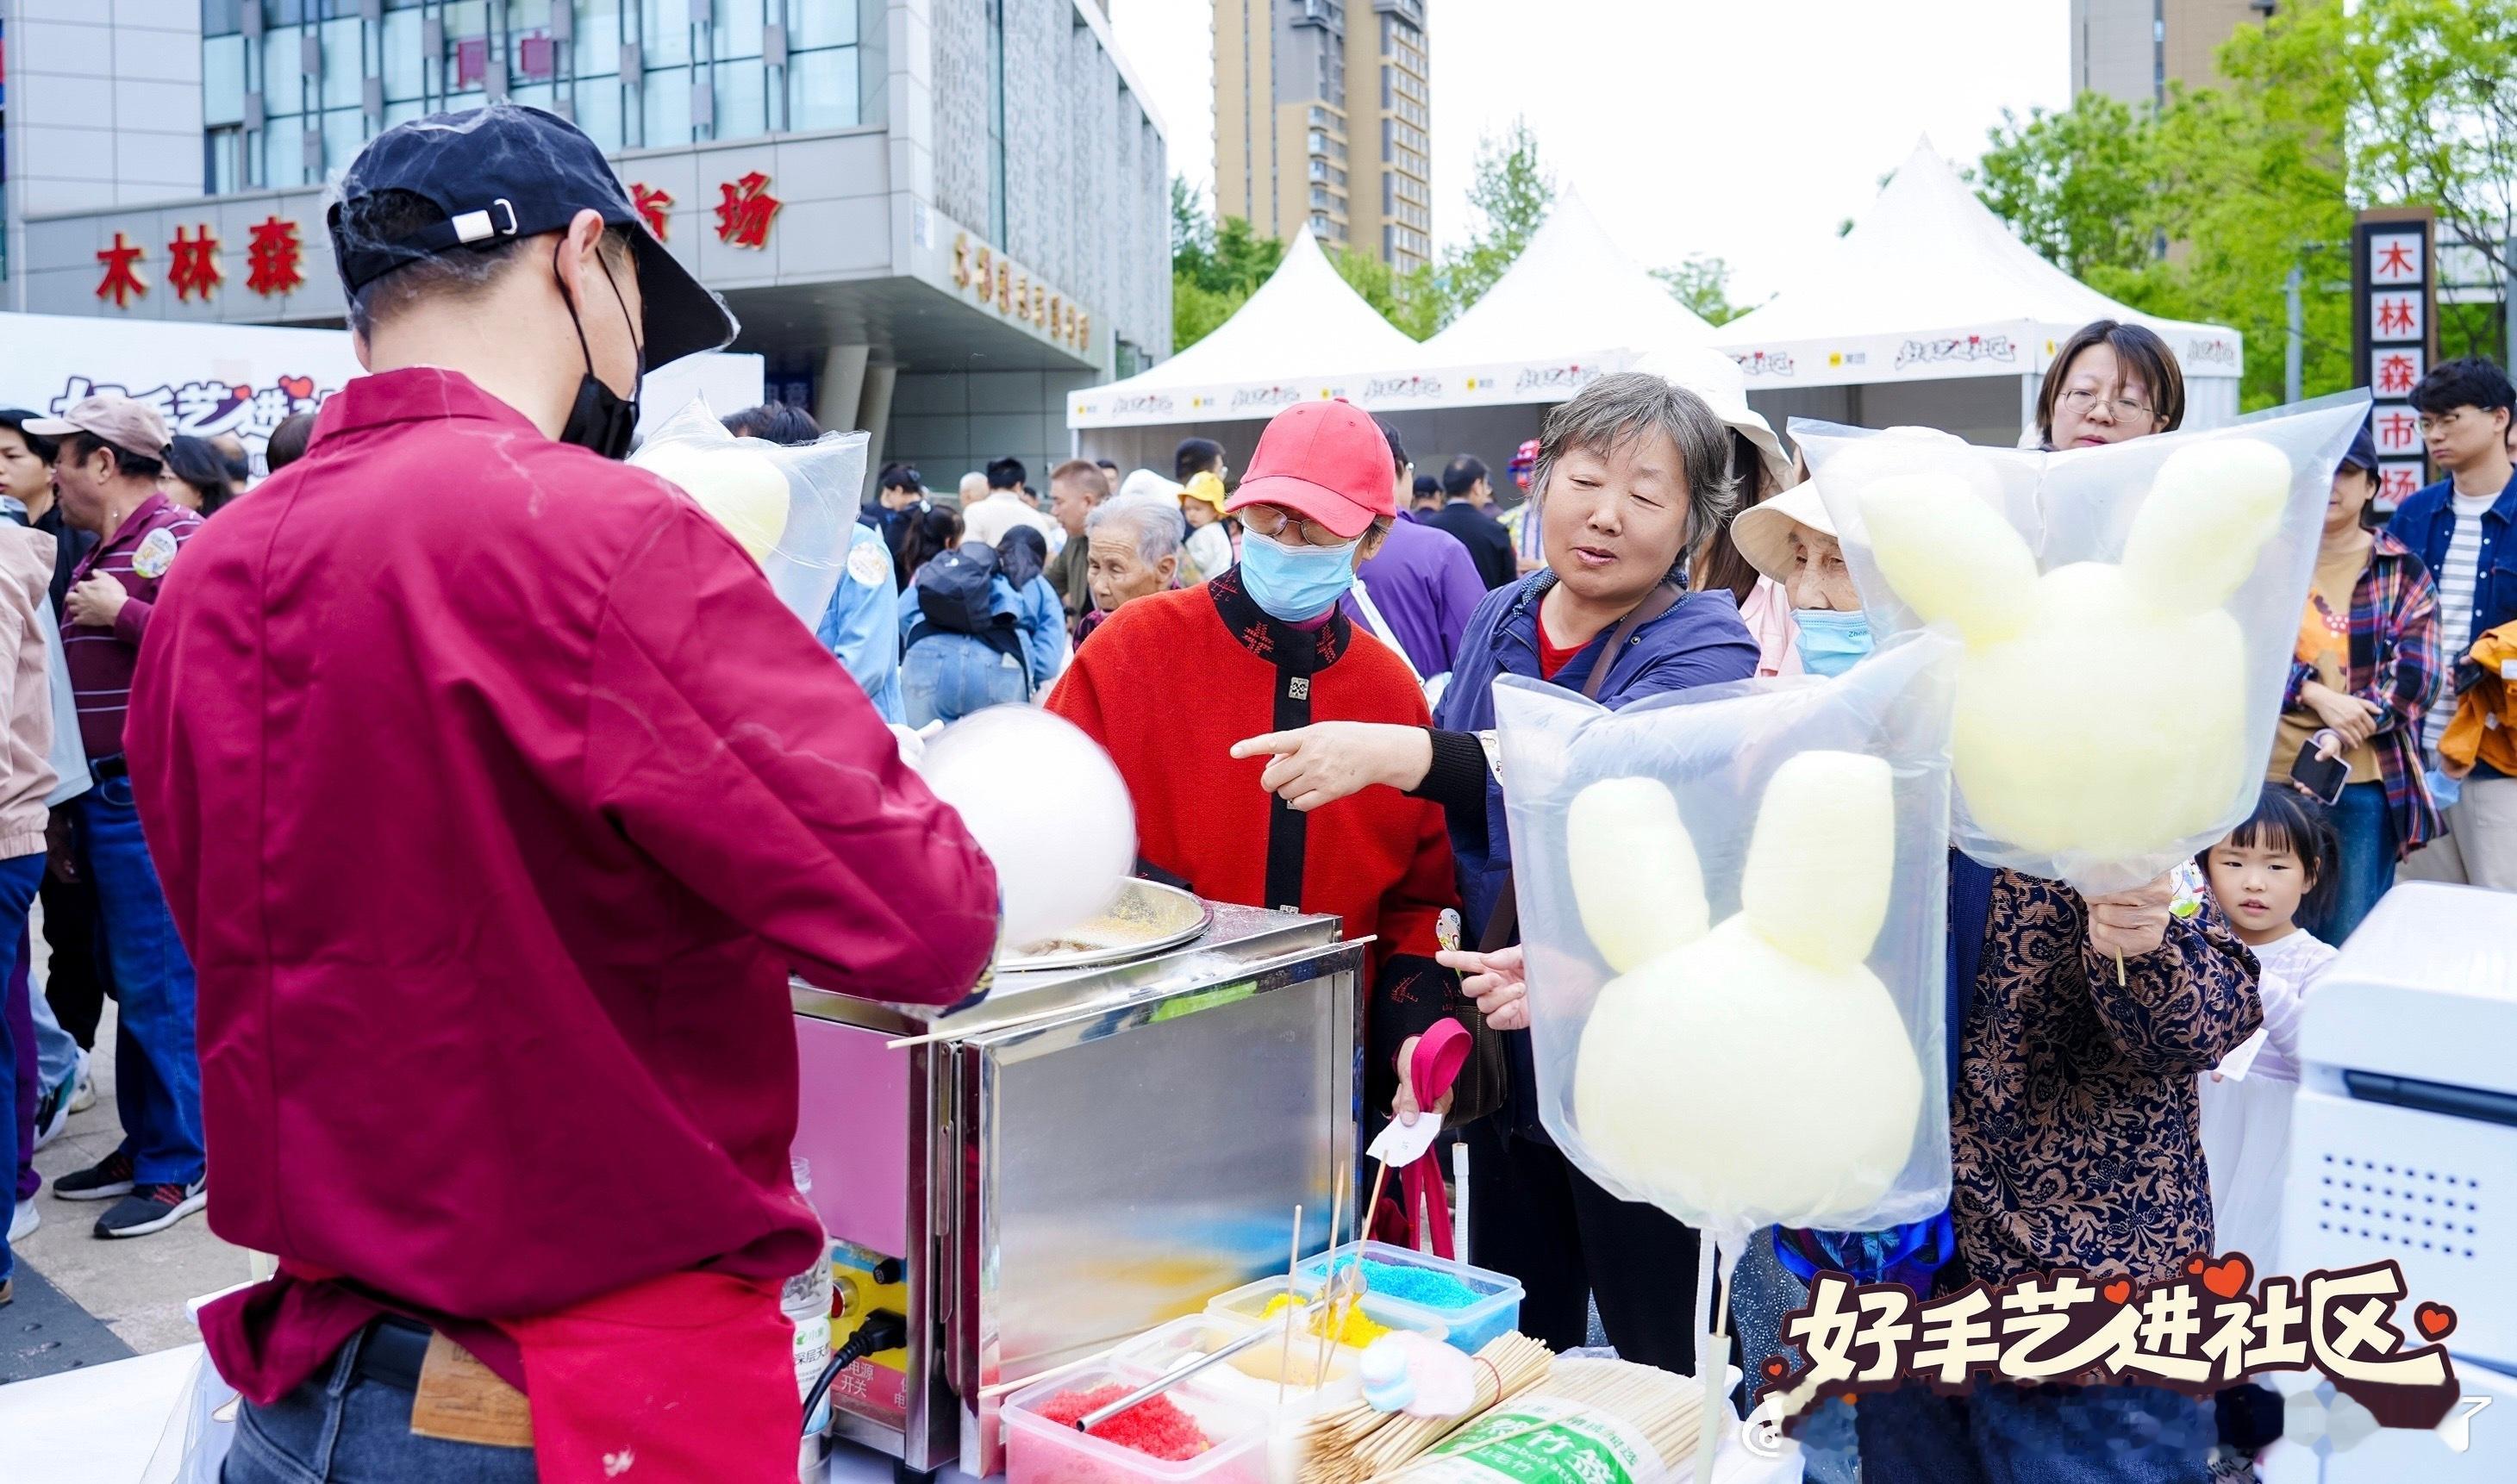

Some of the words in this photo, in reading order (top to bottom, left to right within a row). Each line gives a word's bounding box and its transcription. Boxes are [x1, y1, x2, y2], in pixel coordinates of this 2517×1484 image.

[96, 217, 303, 307] 木林森
[2376, 240, 2415, 503] 木林森市场
[841, 1375, 867, 1398] 开关
